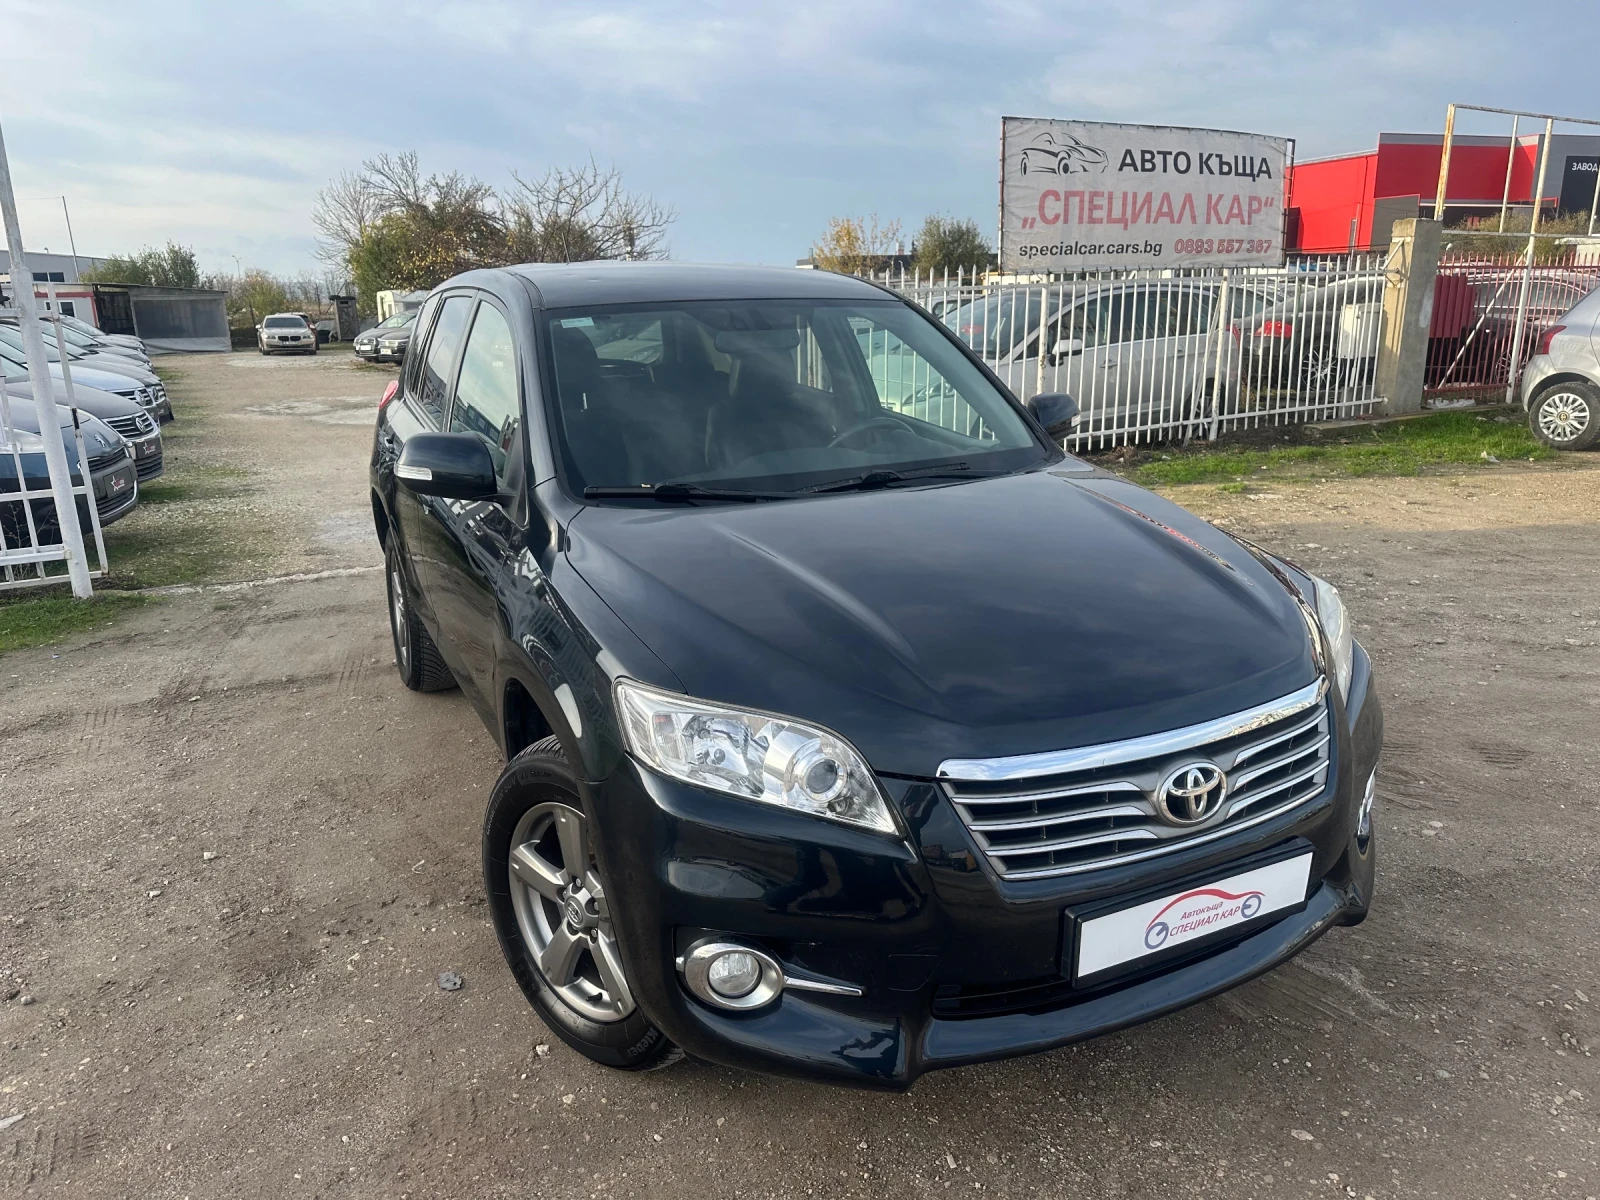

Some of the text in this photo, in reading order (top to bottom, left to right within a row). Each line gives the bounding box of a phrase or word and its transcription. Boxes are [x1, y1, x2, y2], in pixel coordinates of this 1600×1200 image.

[1118, 149, 1272, 182] АВТО КЪЩА
[1571, 162, 1598, 172] ЗАВОД
[1019, 240, 1163, 259] specialcar.cars.bg
[1174, 238, 1273, 254] 0893 557 367
[1169, 905, 1240, 936] СПЕЦИАЛ КАР
[626, 1026, 660, 1059] Kleber
